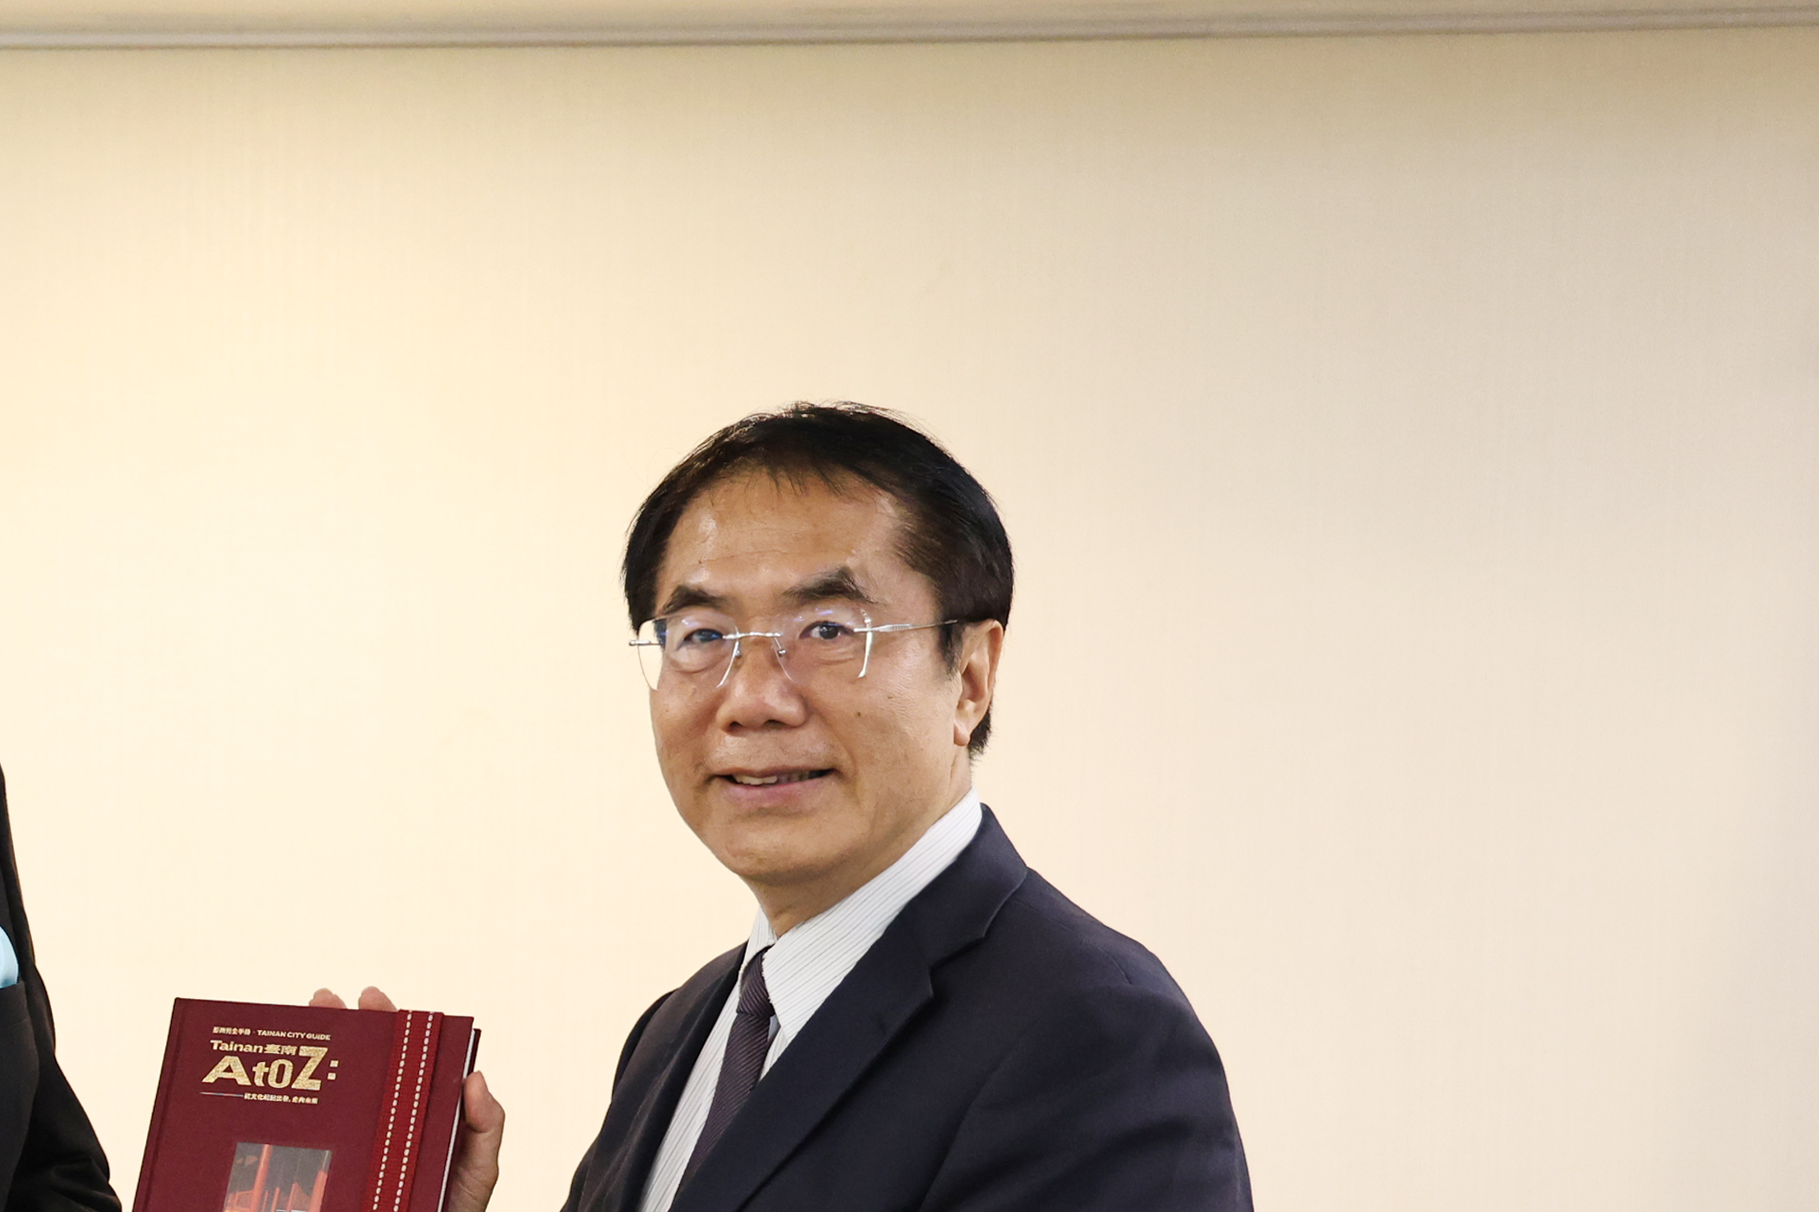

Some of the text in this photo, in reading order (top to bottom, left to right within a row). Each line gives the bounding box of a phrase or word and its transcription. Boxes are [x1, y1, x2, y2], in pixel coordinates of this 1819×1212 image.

[257, 1029, 287, 1038] TAINAN
[287, 1031, 306, 1039] CITY
[306, 1032, 331, 1041] GUIDE
